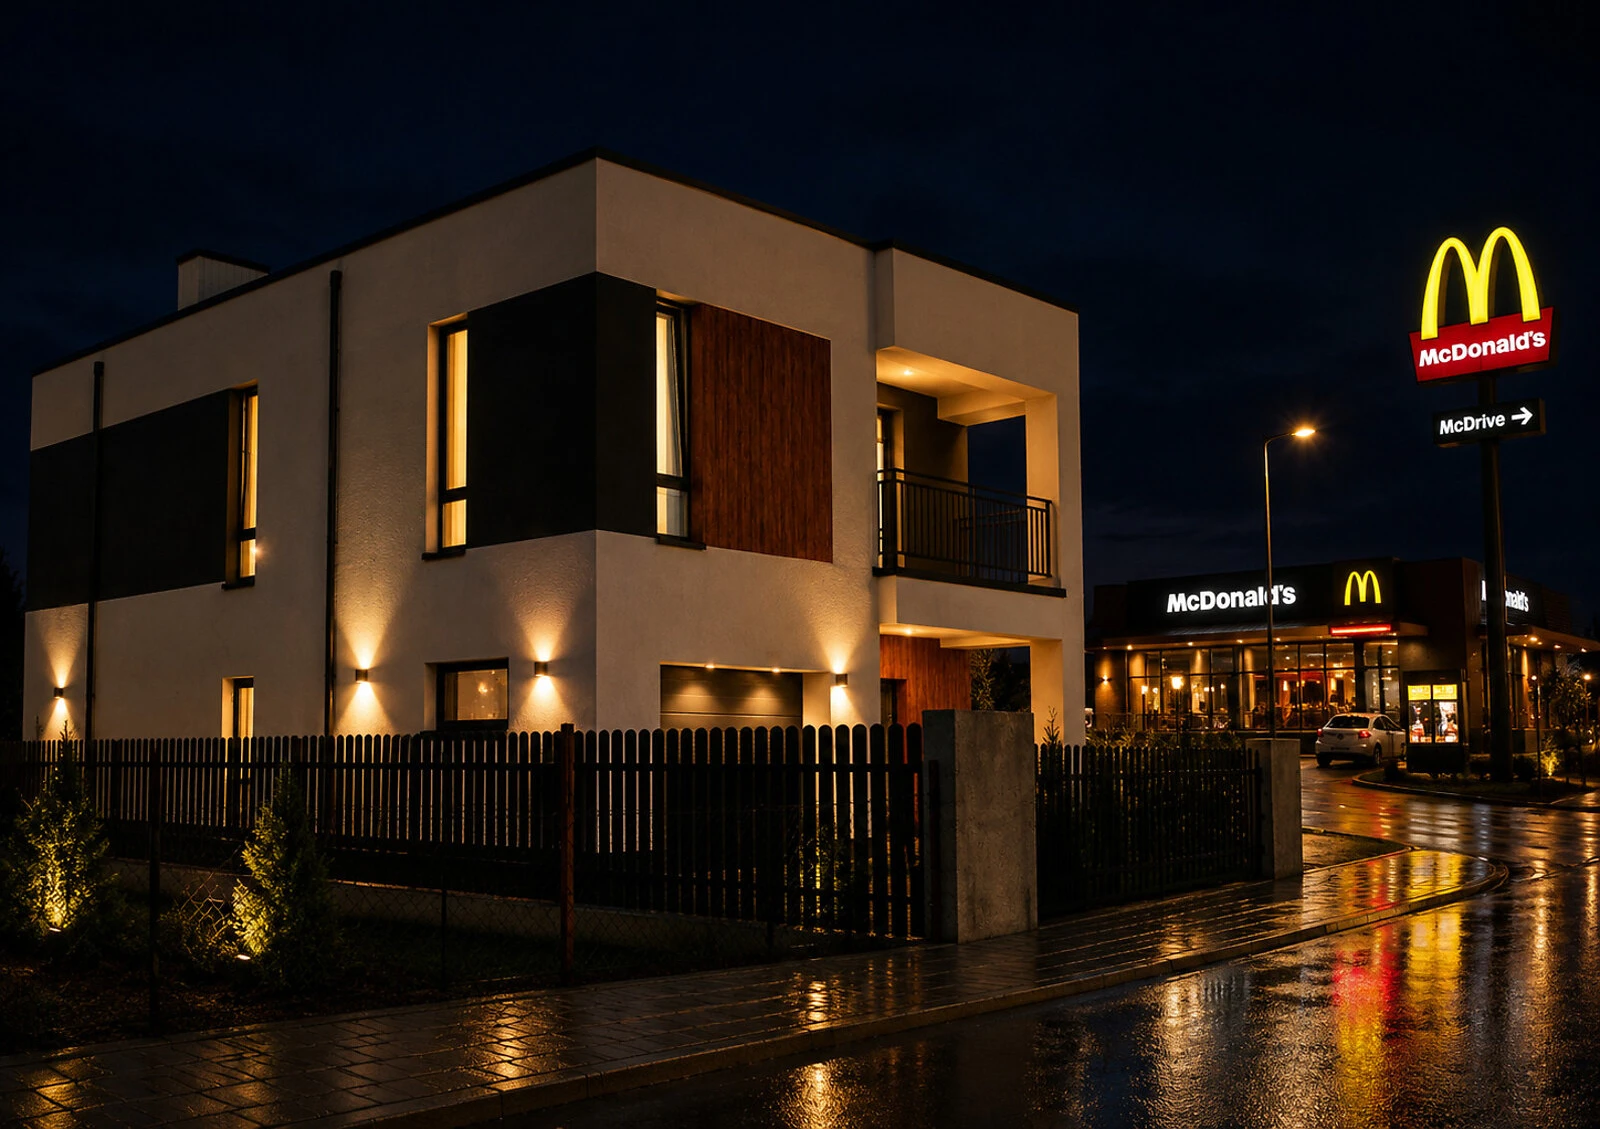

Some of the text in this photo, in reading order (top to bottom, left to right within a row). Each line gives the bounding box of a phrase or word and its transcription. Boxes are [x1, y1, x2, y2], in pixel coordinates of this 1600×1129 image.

[1418, 331, 1546, 367] McDonald's
[1439, 413, 1506, 435] McDrive
[1166, 585, 1297, 613] McDonald's
